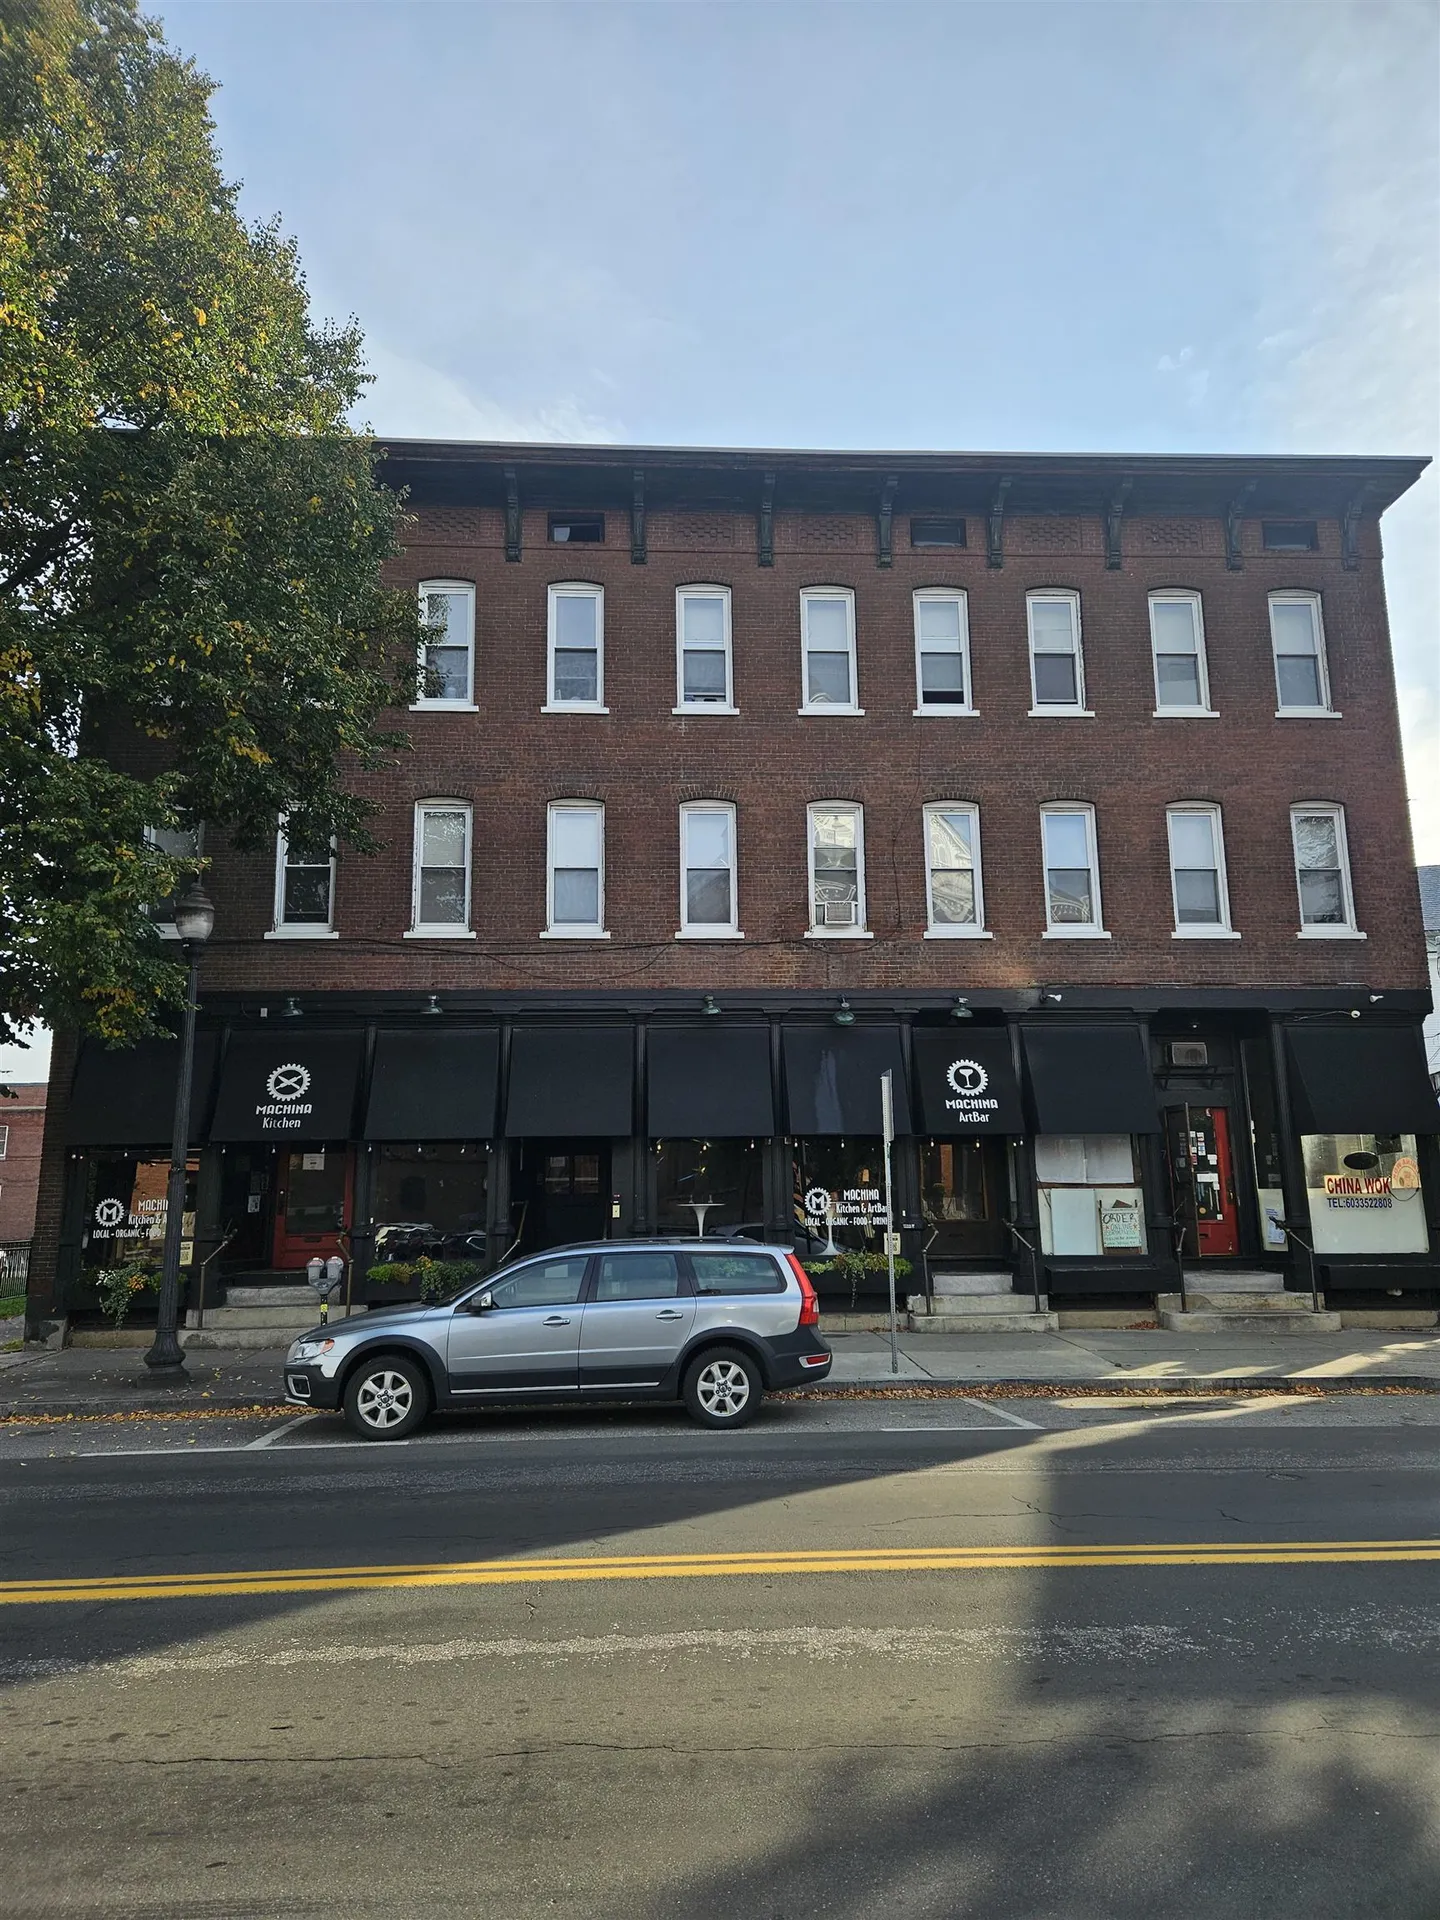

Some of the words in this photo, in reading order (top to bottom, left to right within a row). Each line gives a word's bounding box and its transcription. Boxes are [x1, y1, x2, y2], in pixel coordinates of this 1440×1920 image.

[255, 1104, 313, 1115] MACHINA
[945, 1099, 999, 1109] MACHINA
[959, 1111, 990, 1123] ArtBar
[262, 1117, 301, 1129] Kitchen
[1326, 1178, 1362, 1194] CHINA
[1364, 1178, 1391, 1194] WOK
[843, 1189, 880, 1201] MACHINA
[138, 1199, 169, 1212] MACHI
[836, 1203, 860, 1213] Kitchen
[861, 1203, 867, 1213] &
[1327, 1198, 1393, 1209] TEL:6033522808
[128, 1214, 154, 1225] Kitchen
[804, 1217, 821, 1227] LOCAL
[853, 1217, 868, 1226] FOOD
[93, 1229, 110, 1239] LOCAL
[115, 1228, 140, 1238] ORGANIC
